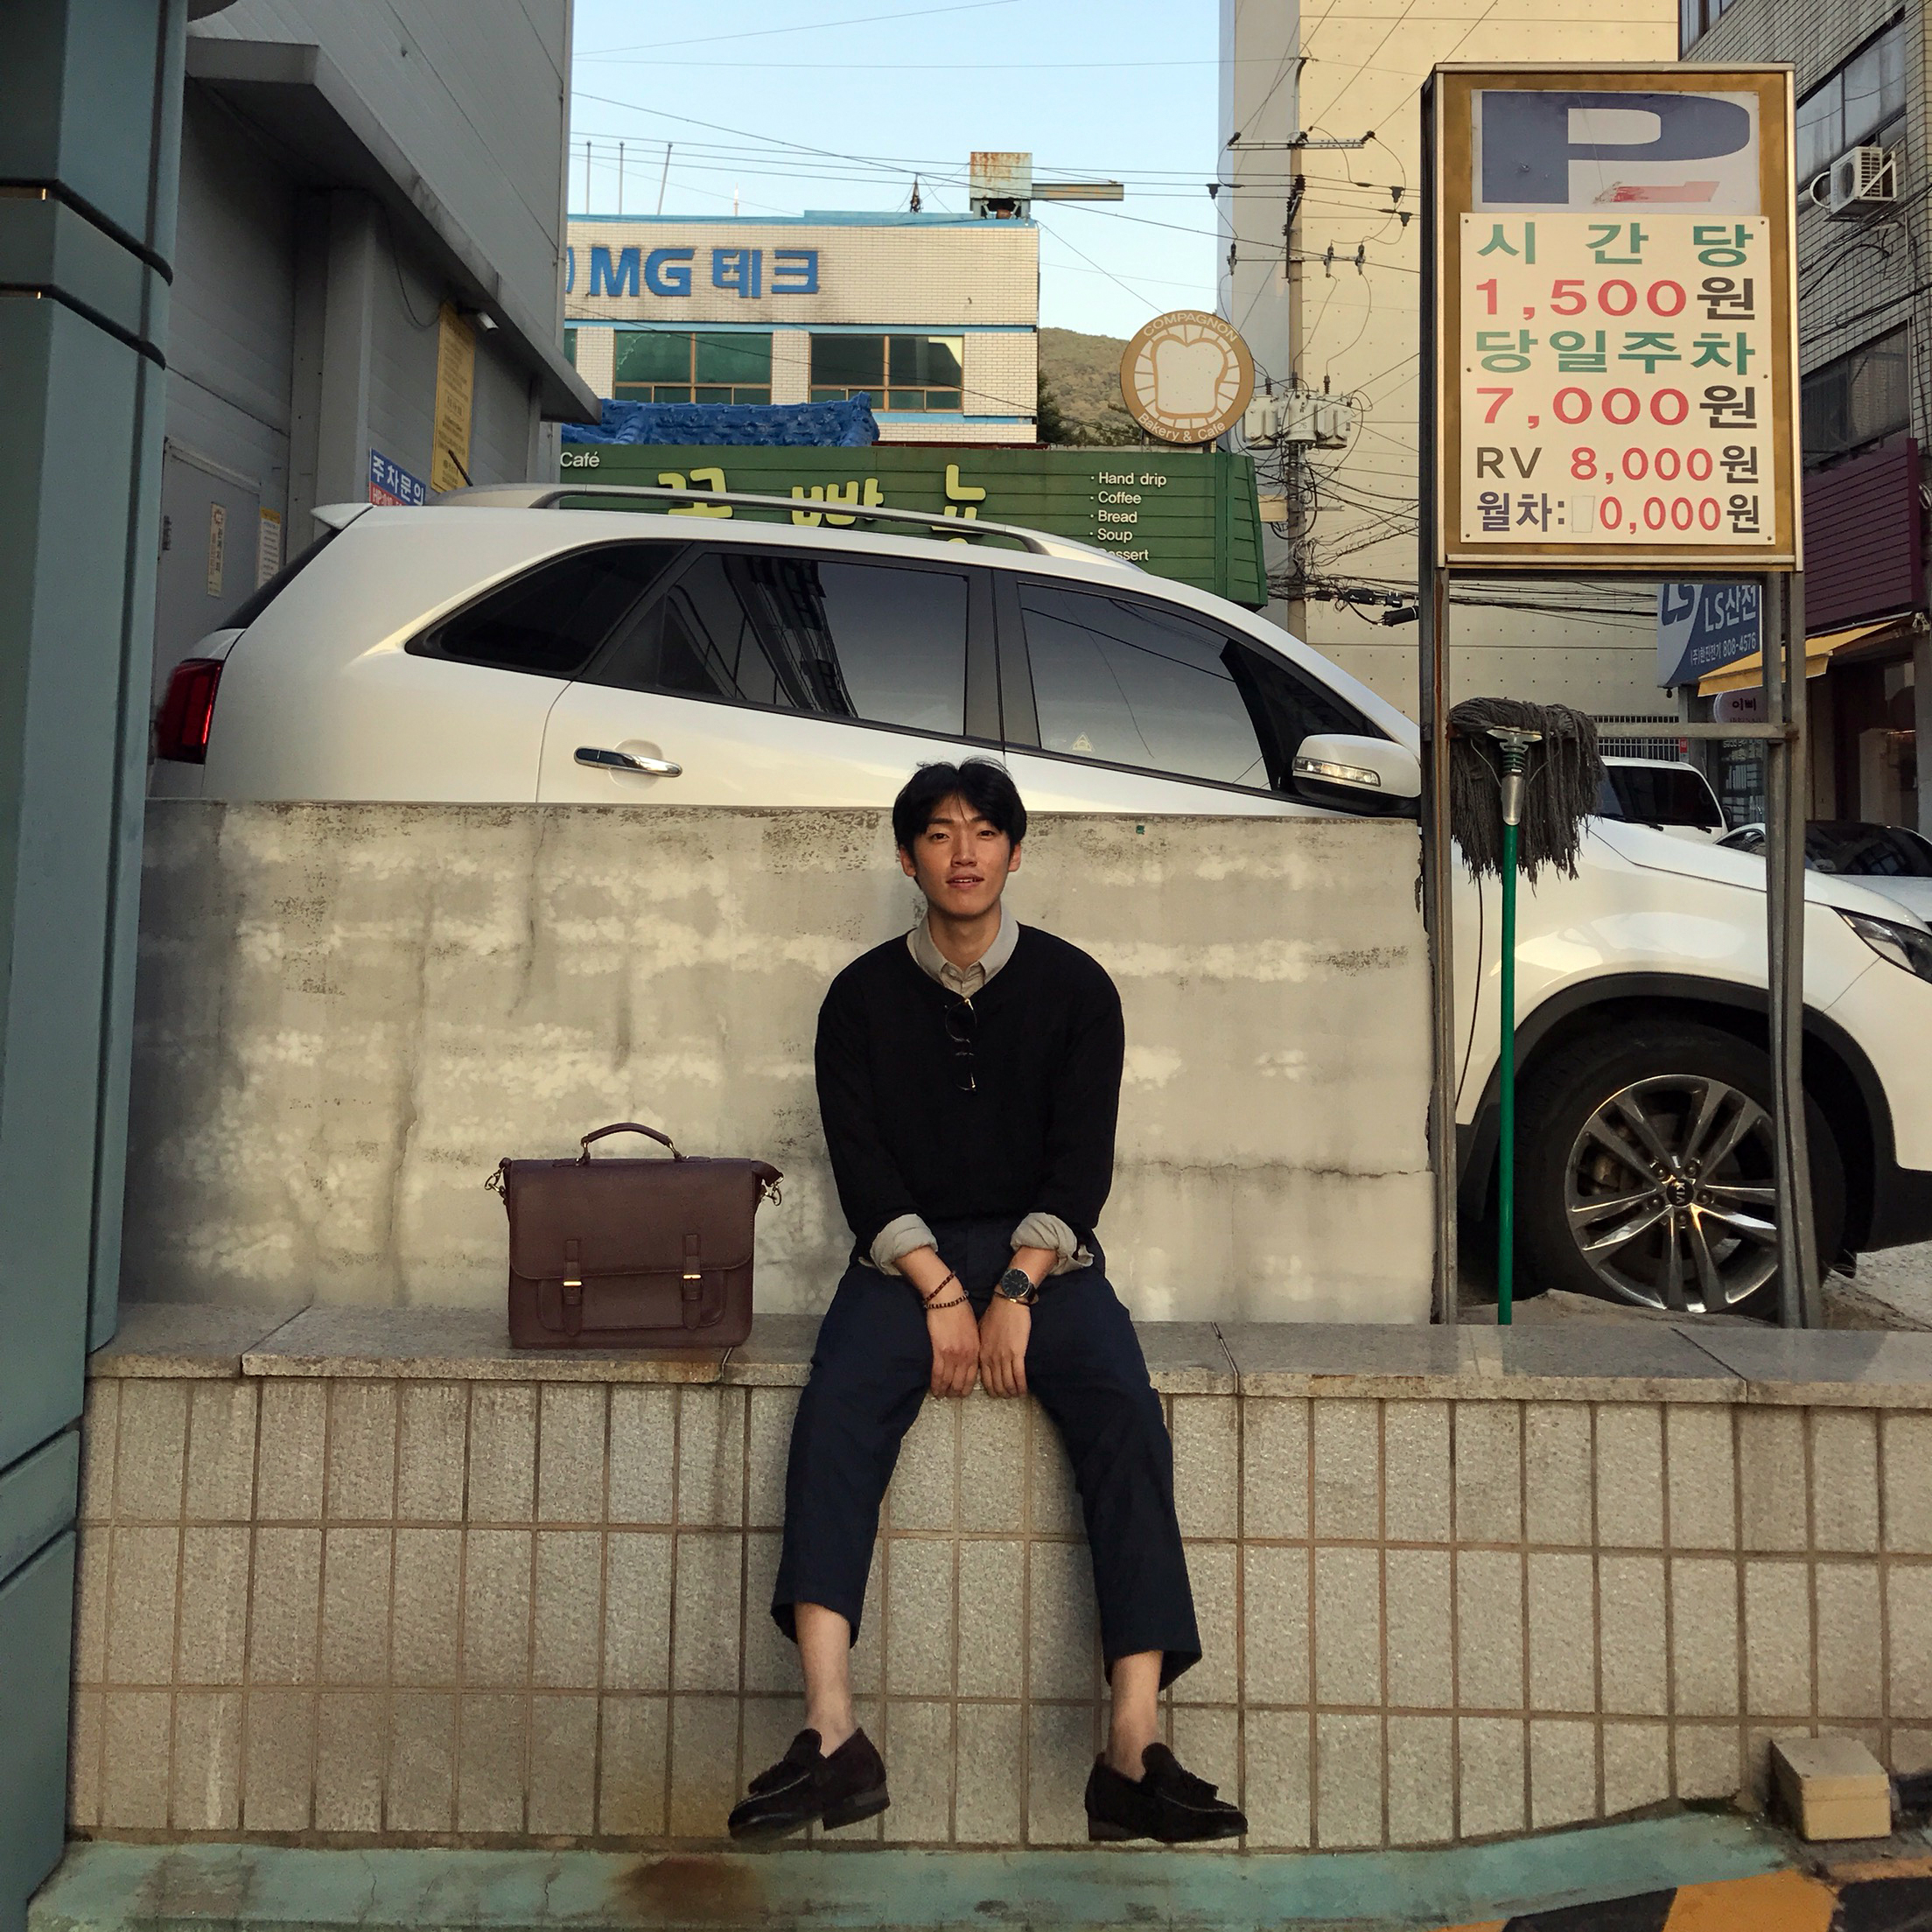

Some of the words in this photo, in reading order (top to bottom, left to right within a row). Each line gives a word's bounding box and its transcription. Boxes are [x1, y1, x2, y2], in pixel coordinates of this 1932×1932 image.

[1482, 91, 1750, 204] P
[1476, 278, 1755, 320] 1,500원
[1144, 313, 1238, 342] COMPAGNON
[1476, 330, 1756, 375] 당일주차
[1476, 386, 1757, 429] 7,000원
[1138, 413, 1180, 442] Bakery
[1183, 430, 1193, 442] &
[1198, 423, 1225, 440] Cafe
[560, 451, 600, 467] Café
[1477, 447, 1543, 479] RV
[1571, 444, 1760, 484] 8,000원
[373, 455, 424, 506] 주차문의
[1098, 472, 1134, 485] Hand
[1140, 473, 1166, 487] drip
[1098, 491, 1142, 504] Coffee
[1098, 510, 1138, 523] Bread
[1572, 494, 1760, 535] 0,000원
[1097, 528, 1132, 543] Soup
[1099, 548, 1149, 561] ssert
[1704, 585, 1756, 633] LS산전
[1723, 632, 1757, 658] 808-4576
[1675, 1182, 1685, 1204] KIA
